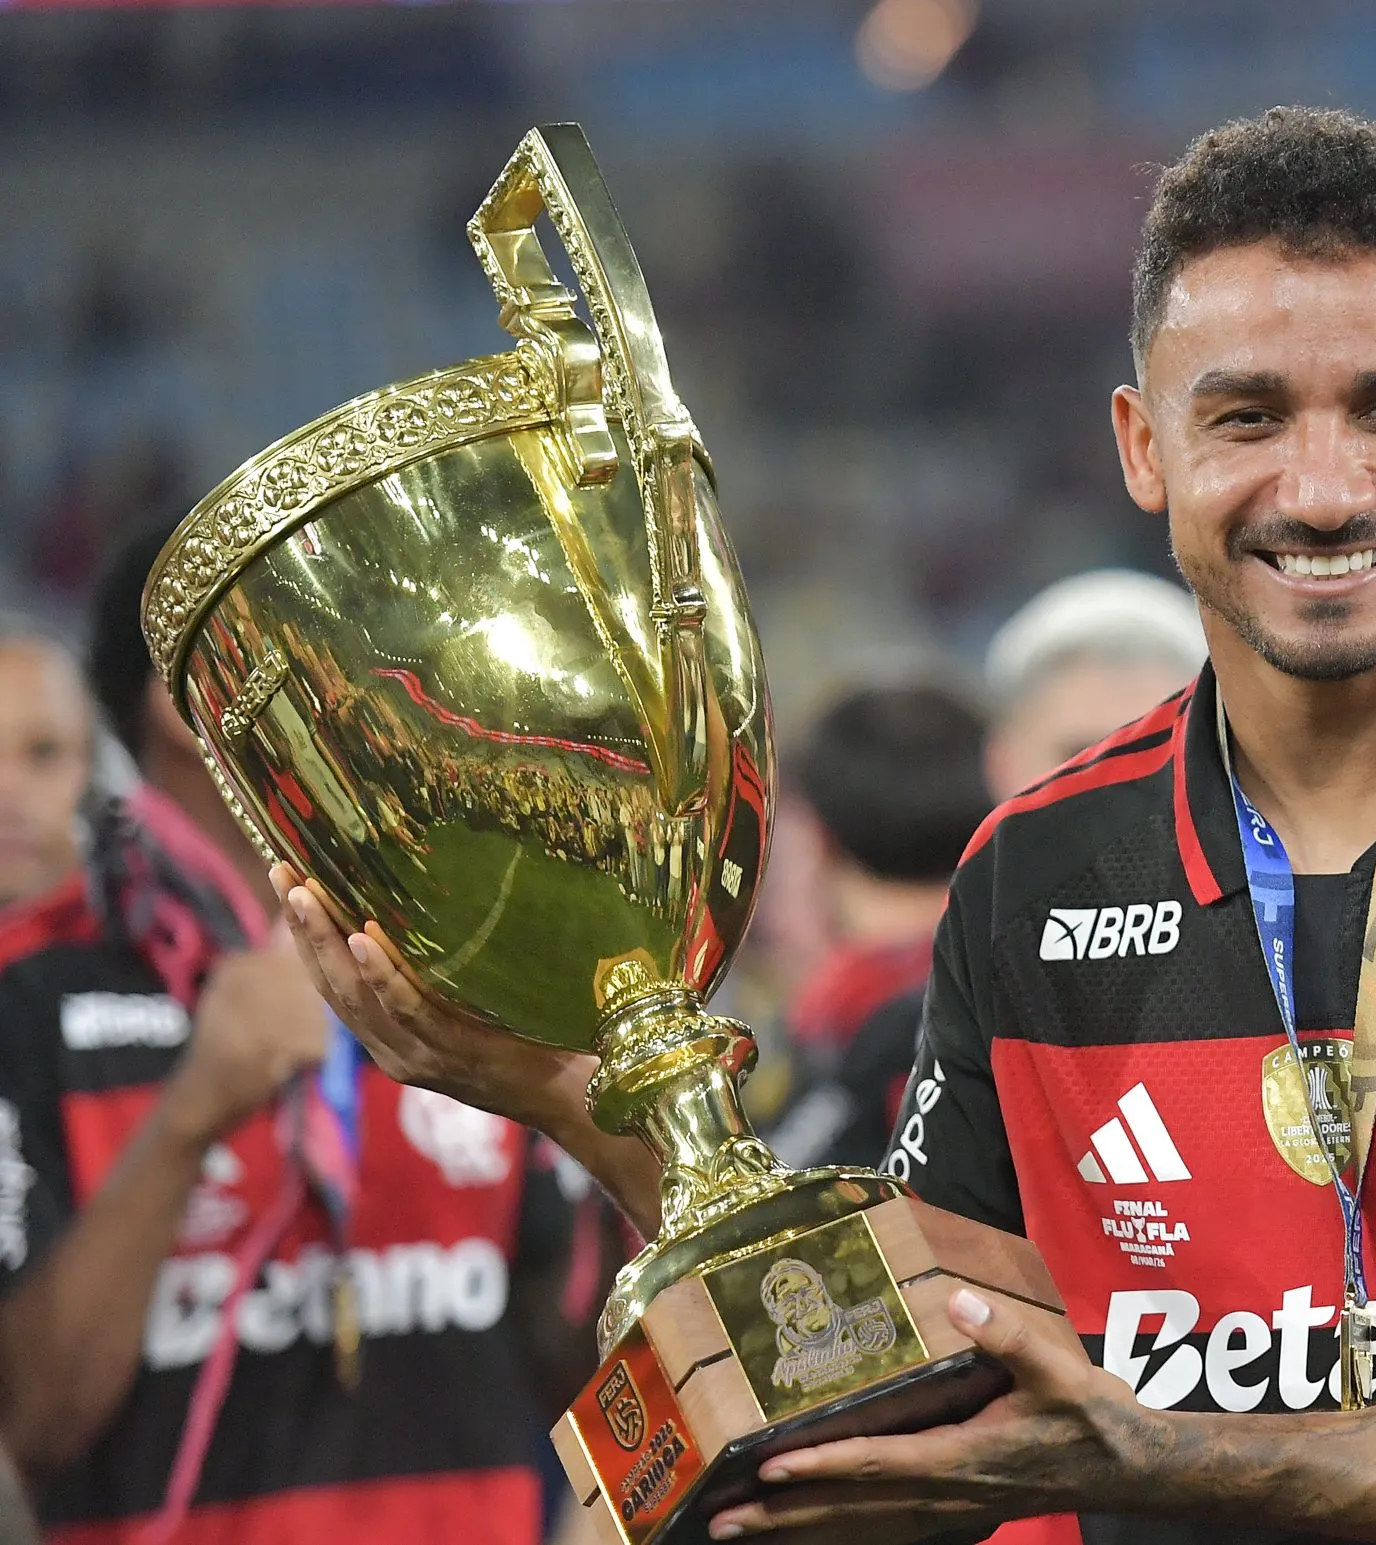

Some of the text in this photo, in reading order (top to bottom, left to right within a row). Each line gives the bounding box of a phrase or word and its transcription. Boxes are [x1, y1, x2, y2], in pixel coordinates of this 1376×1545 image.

[1088, 900, 1183, 960] BRB
[1271, 1044, 1349, 1068] CAMPEÓ
[888, 1057, 946, 1182] ope
[1281, 1122, 1351, 1137] LIBERTDORE
[1327, 1135, 1350, 1145] ETERN
[1113, 1200, 1168, 1216] FINAL
[1101, 1217, 1191, 1241] FLU FLA
[598, 1367, 626, 1408] FERJ
[622, 1433, 689, 1522] CARIOCA
